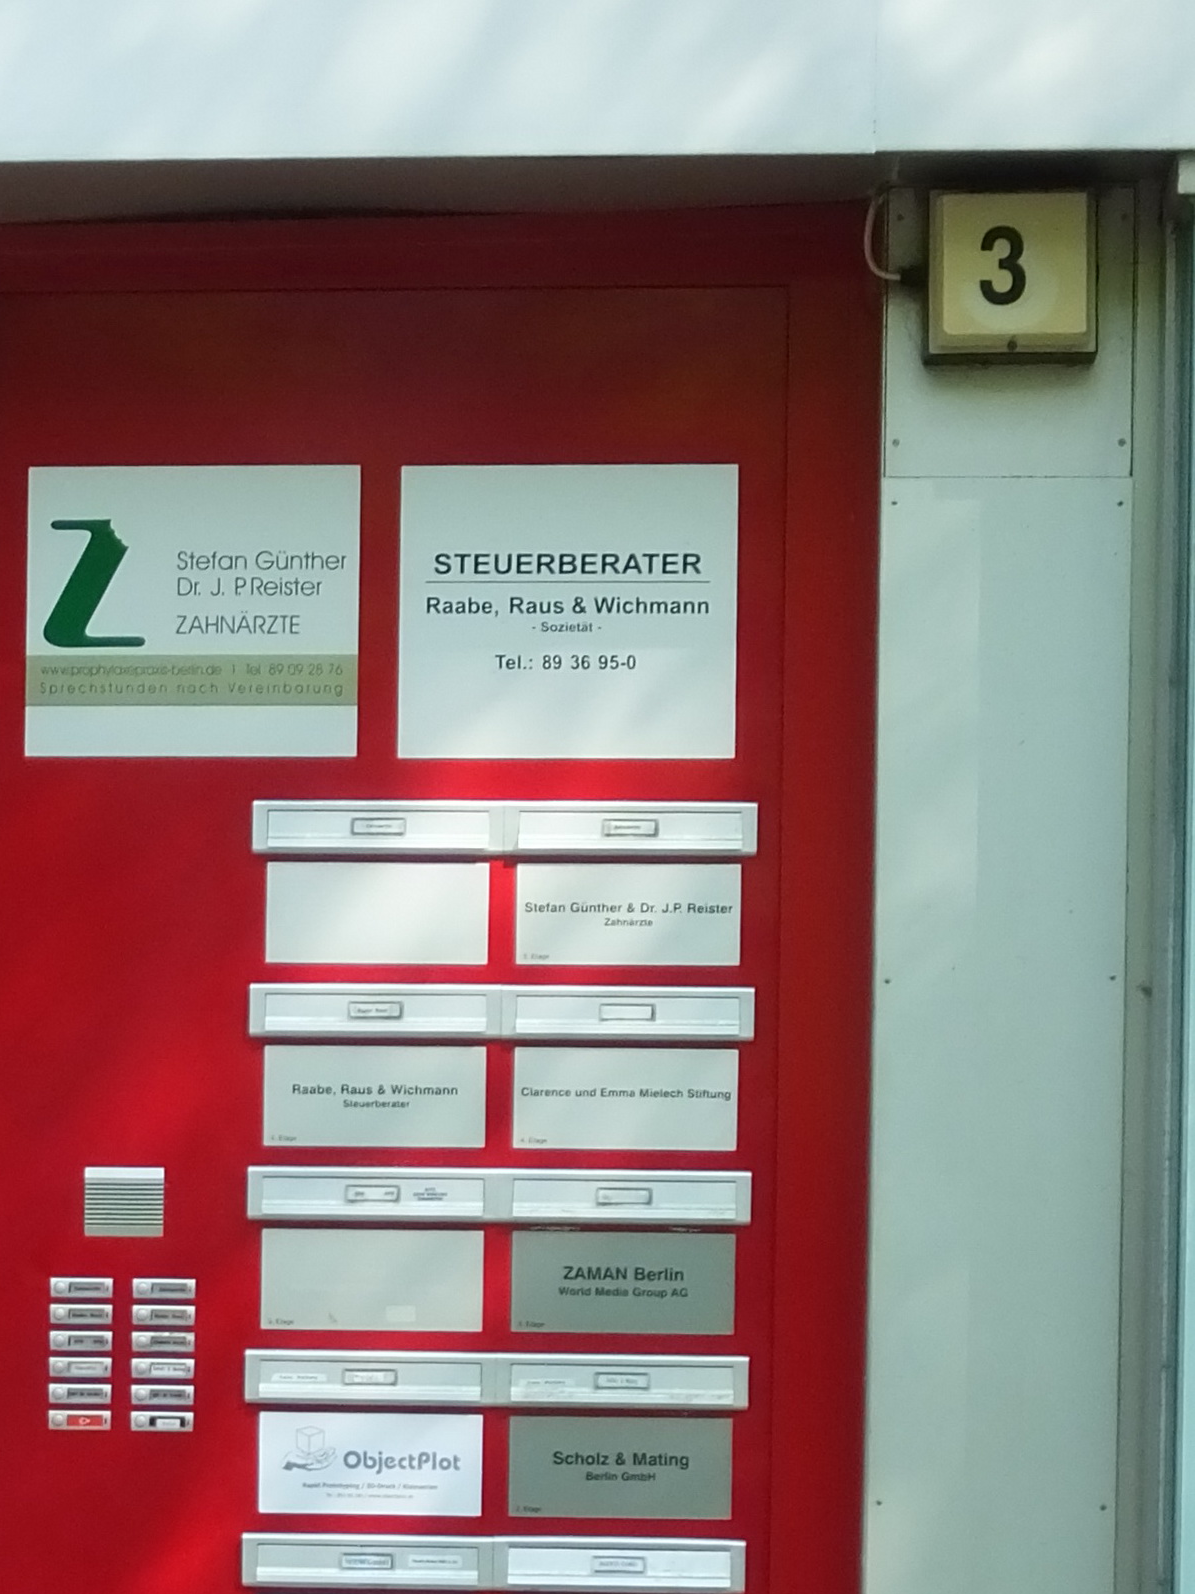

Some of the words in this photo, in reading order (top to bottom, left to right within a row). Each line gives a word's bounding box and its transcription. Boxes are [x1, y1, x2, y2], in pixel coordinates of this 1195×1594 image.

[980, 225, 1026, 305] 3
[177, 550, 248, 570] Stefan
[256, 550, 346, 571] Günther
[433, 553, 702, 575] STEUERBERATER
[177, 577, 201, 596] Dr.
[210, 577, 225, 596] J.
[426, 596, 499, 617] Raabe,
[509, 596, 564, 615] Raus
[572, 597, 587, 615] &
[594, 596, 710, 615] Wichmann
[175, 610, 300, 634] ZAHNÄRZTE
[540, 621, 593, 633] Sozietät
[268, 663, 284, 676] 89
[308, 663, 323, 676] 28
[495, 654, 533, 670] Tel.:
[542, 655, 562, 670] 89
[570, 655, 590, 670] 36
[598, 655, 637, 670] 95-0
[39, 681, 168, 695] Sprechstunden
[176, 682, 218, 694] nach
[228, 682, 344, 697] Vereinbarung
[524, 902, 565, 913] Stefan
[570, 902, 622, 913] Günther
[627, 903, 635, 913] &
[640, 903, 657, 913] Dr.
[687, 903, 733, 914] Reister
[604, 918, 653, 927] Zahnärzte
[292, 1083, 336, 1096] Raabe,
[340, 1083, 373, 1096] Raus
[377, 1084, 386, 1096] &
[390, 1083, 459, 1096] Wichmann
[521, 1087, 571, 1099] Clarence
[575, 1087, 597, 1099] und
[600, 1087, 636, 1099] Emma
[639, 1087, 684, 1099] Mielech
[687, 1088, 732, 1102] Stiftung
[342, 1099, 411, 1109] Steuerberater
[562, 1266, 628, 1282] ZAMAN
[634, 1266, 685, 1282] Berlin
[558, 1286, 591, 1297] World
[594, 1287, 629, 1297] Media
[632, 1288, 668, 1300] Group
[670, 1288, 689, 1298] AG
[343, 1450, 461, 1476] ObjectPlot
[552, 1450, 611, 1467] Scholz
[615, 1451, 627, 1466] &
[632, 1451, 690, 1471] Mating
[585, 1472, 617, 1482] Berlin
[621, 1472, 657, 1482] GmbH
